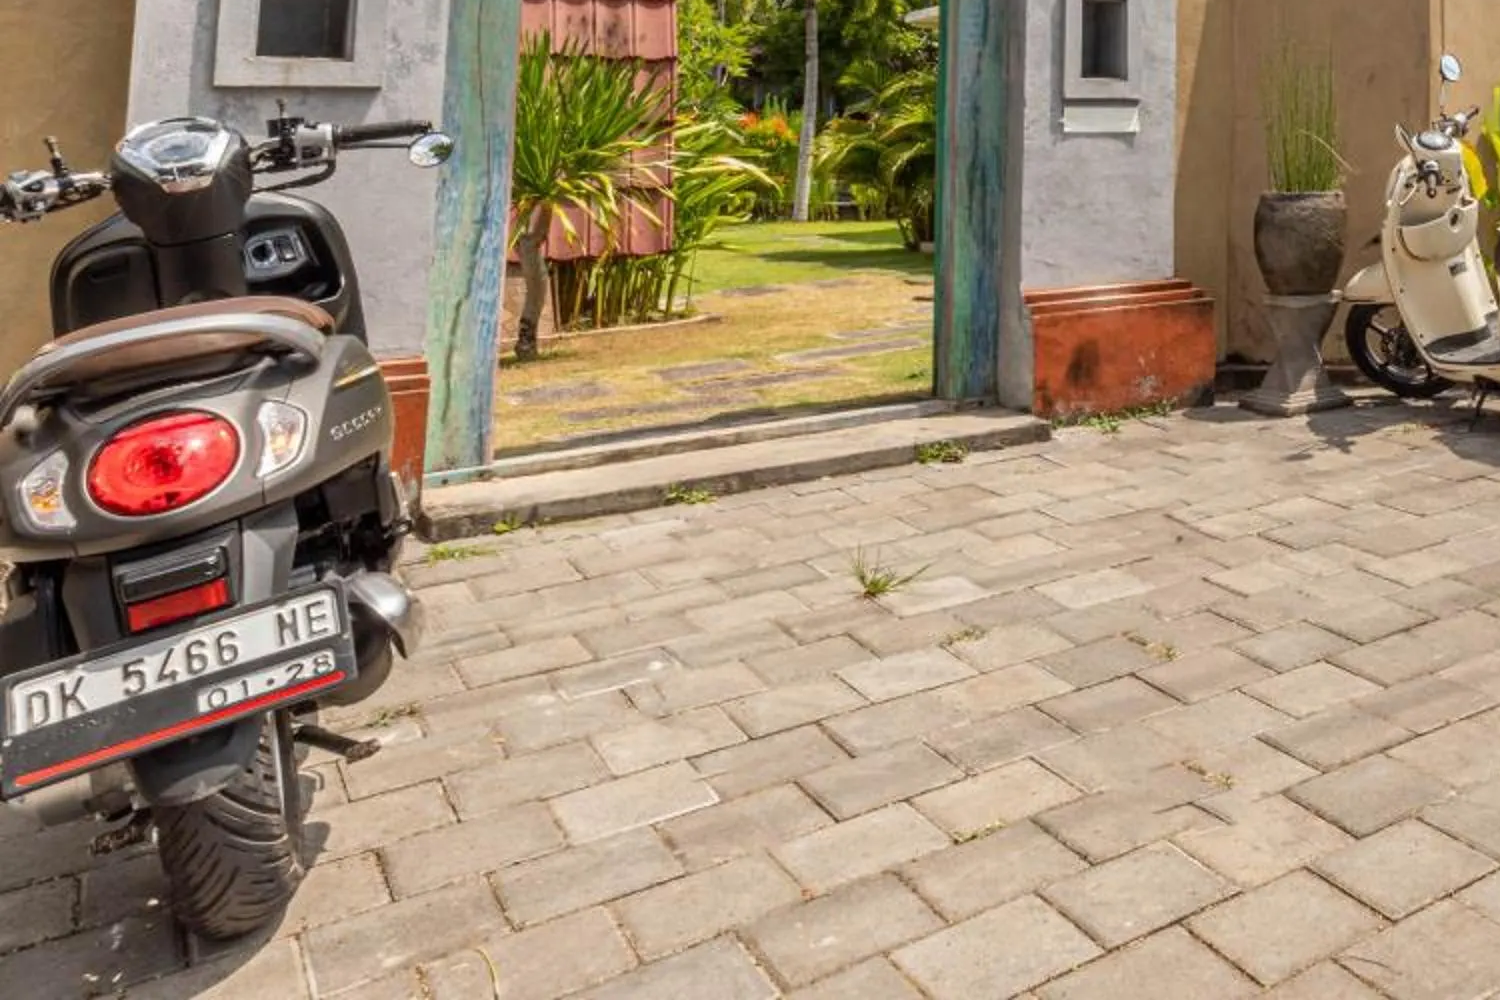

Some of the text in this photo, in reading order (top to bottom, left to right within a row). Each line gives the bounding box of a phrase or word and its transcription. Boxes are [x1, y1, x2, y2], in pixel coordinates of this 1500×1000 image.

[27, 599, 330, 729] DK 5466 NE
